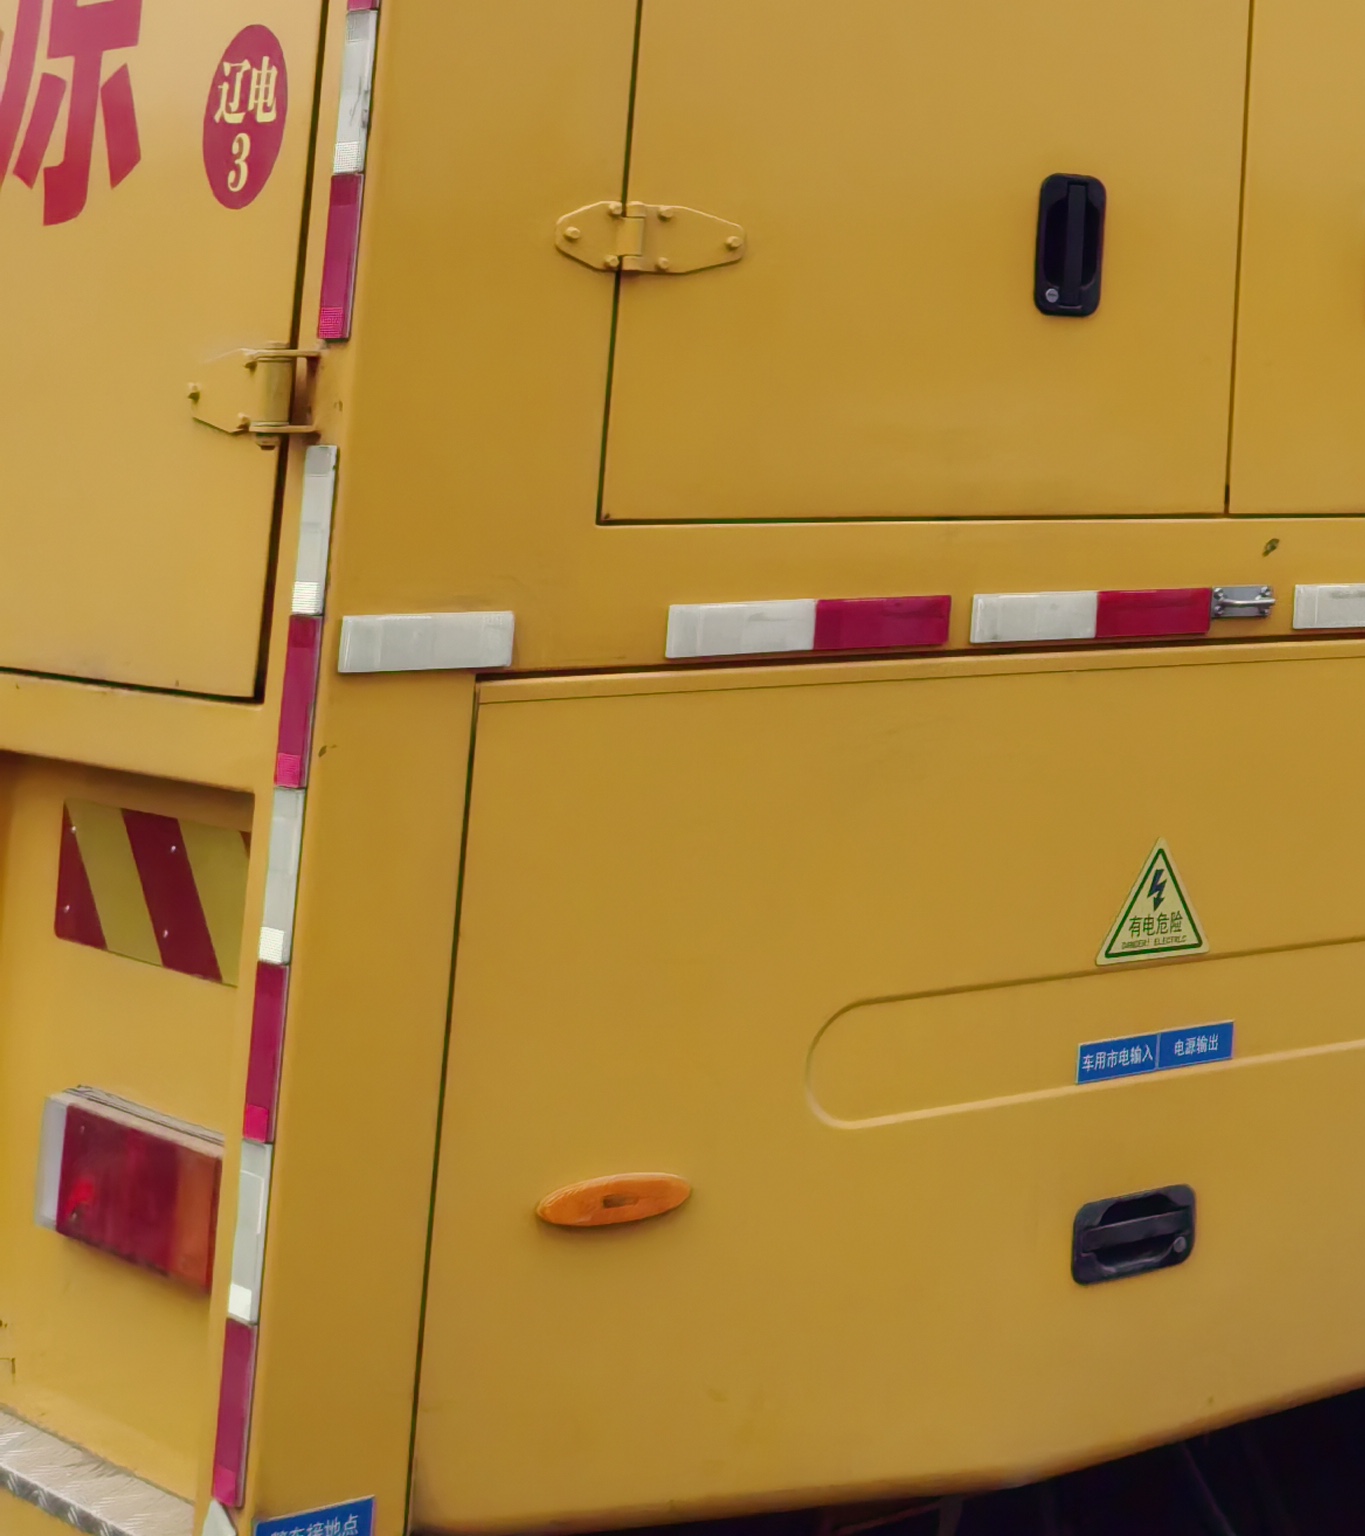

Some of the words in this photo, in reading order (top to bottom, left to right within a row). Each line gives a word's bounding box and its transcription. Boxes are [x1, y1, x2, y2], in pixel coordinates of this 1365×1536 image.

[213, 56, 279, 124] 辽电
[228, 132, 251, 192] 3
[1128, 910, 1183, 939] 有电危险
[1082, 1044, 1154, 1073] 车用市电输入
[1174, 1033, 1219, 1057] 电源输出
